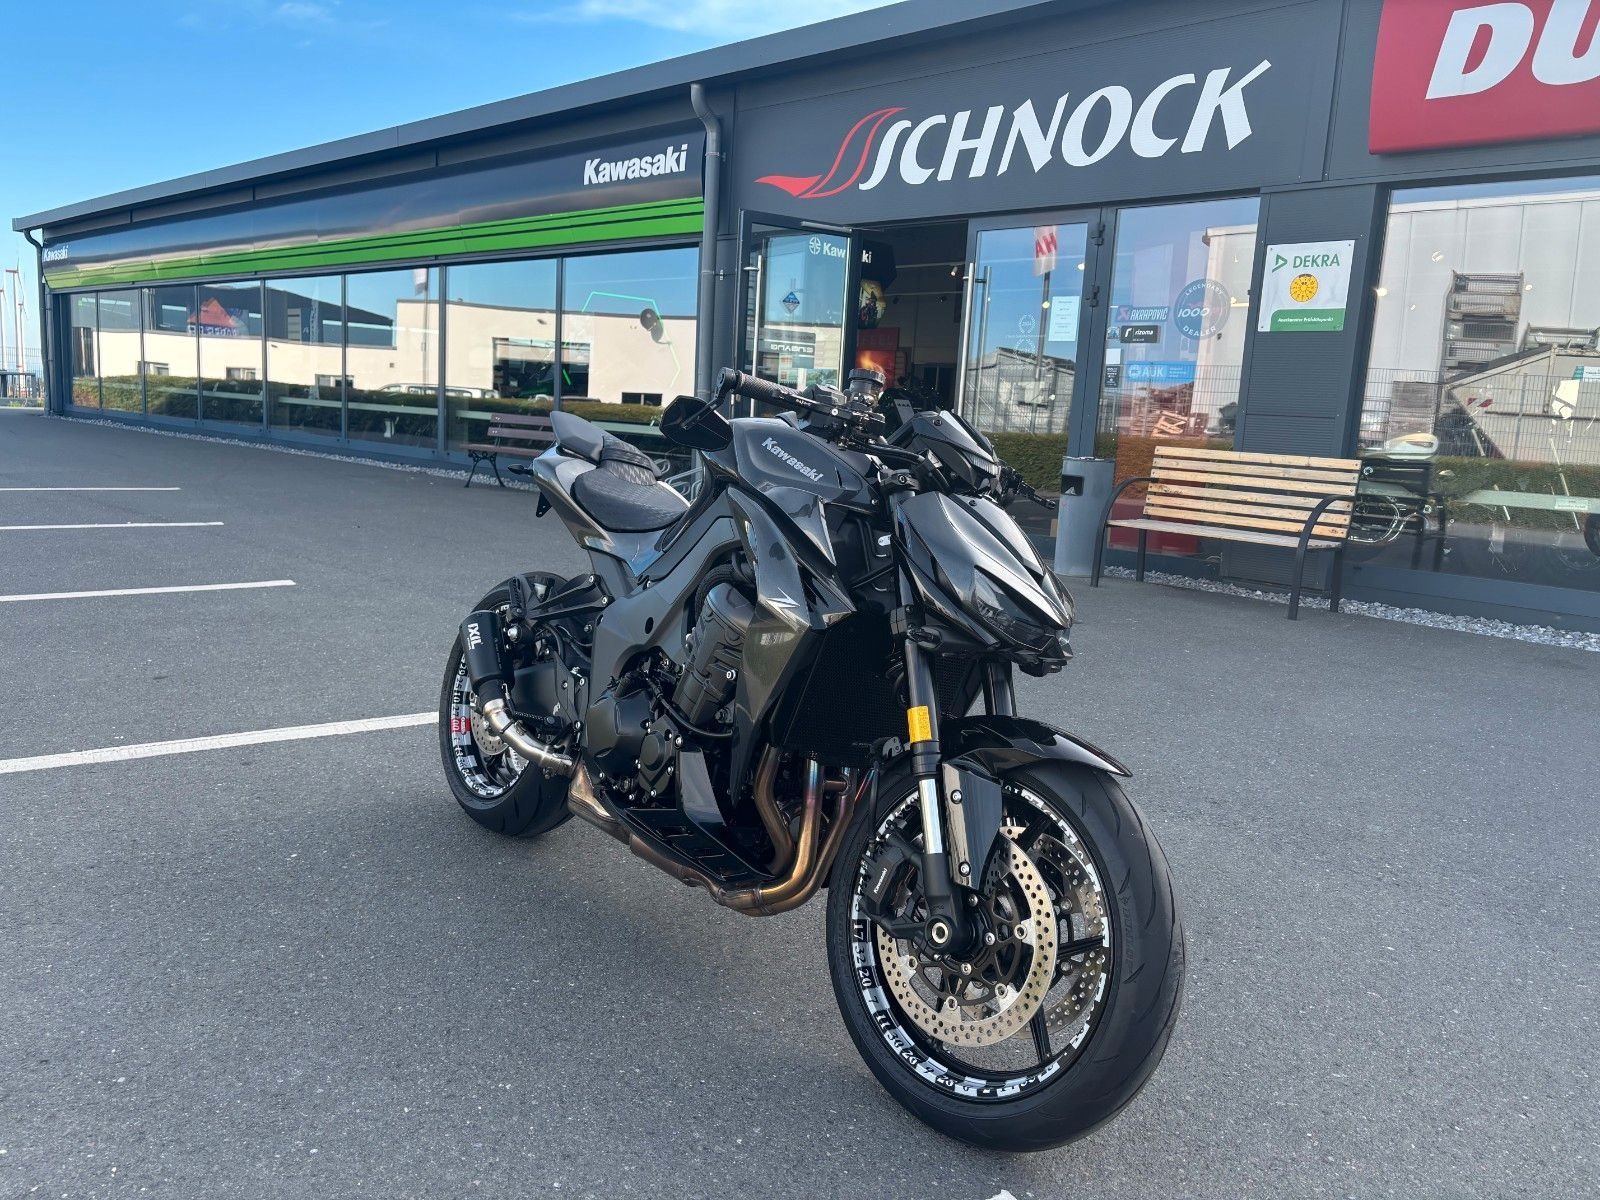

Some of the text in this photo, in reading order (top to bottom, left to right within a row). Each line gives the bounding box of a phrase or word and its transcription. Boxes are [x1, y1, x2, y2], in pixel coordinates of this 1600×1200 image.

[858, 59, 1272, 190] SCHNOCK
[583, 143, 688, 186] Kawasaki
[43, 245, 69, 262] Kawasaki
[1292, 253, 1340, 269] DEKRA
[1177, 307, 1210, 318] 1000
[1183, 325, 1216, 337] DEALER
[761, 437, 824, 482] Kawasaki
[453, 690, 461, 704] 10
[853, 923, 864, 941] 17
[855, 946, 866, 964] 32
[859, 968, 872, 988] 20
[868, 995, 879, 1004] 7
[876, 1014, 891, 1030] 11
